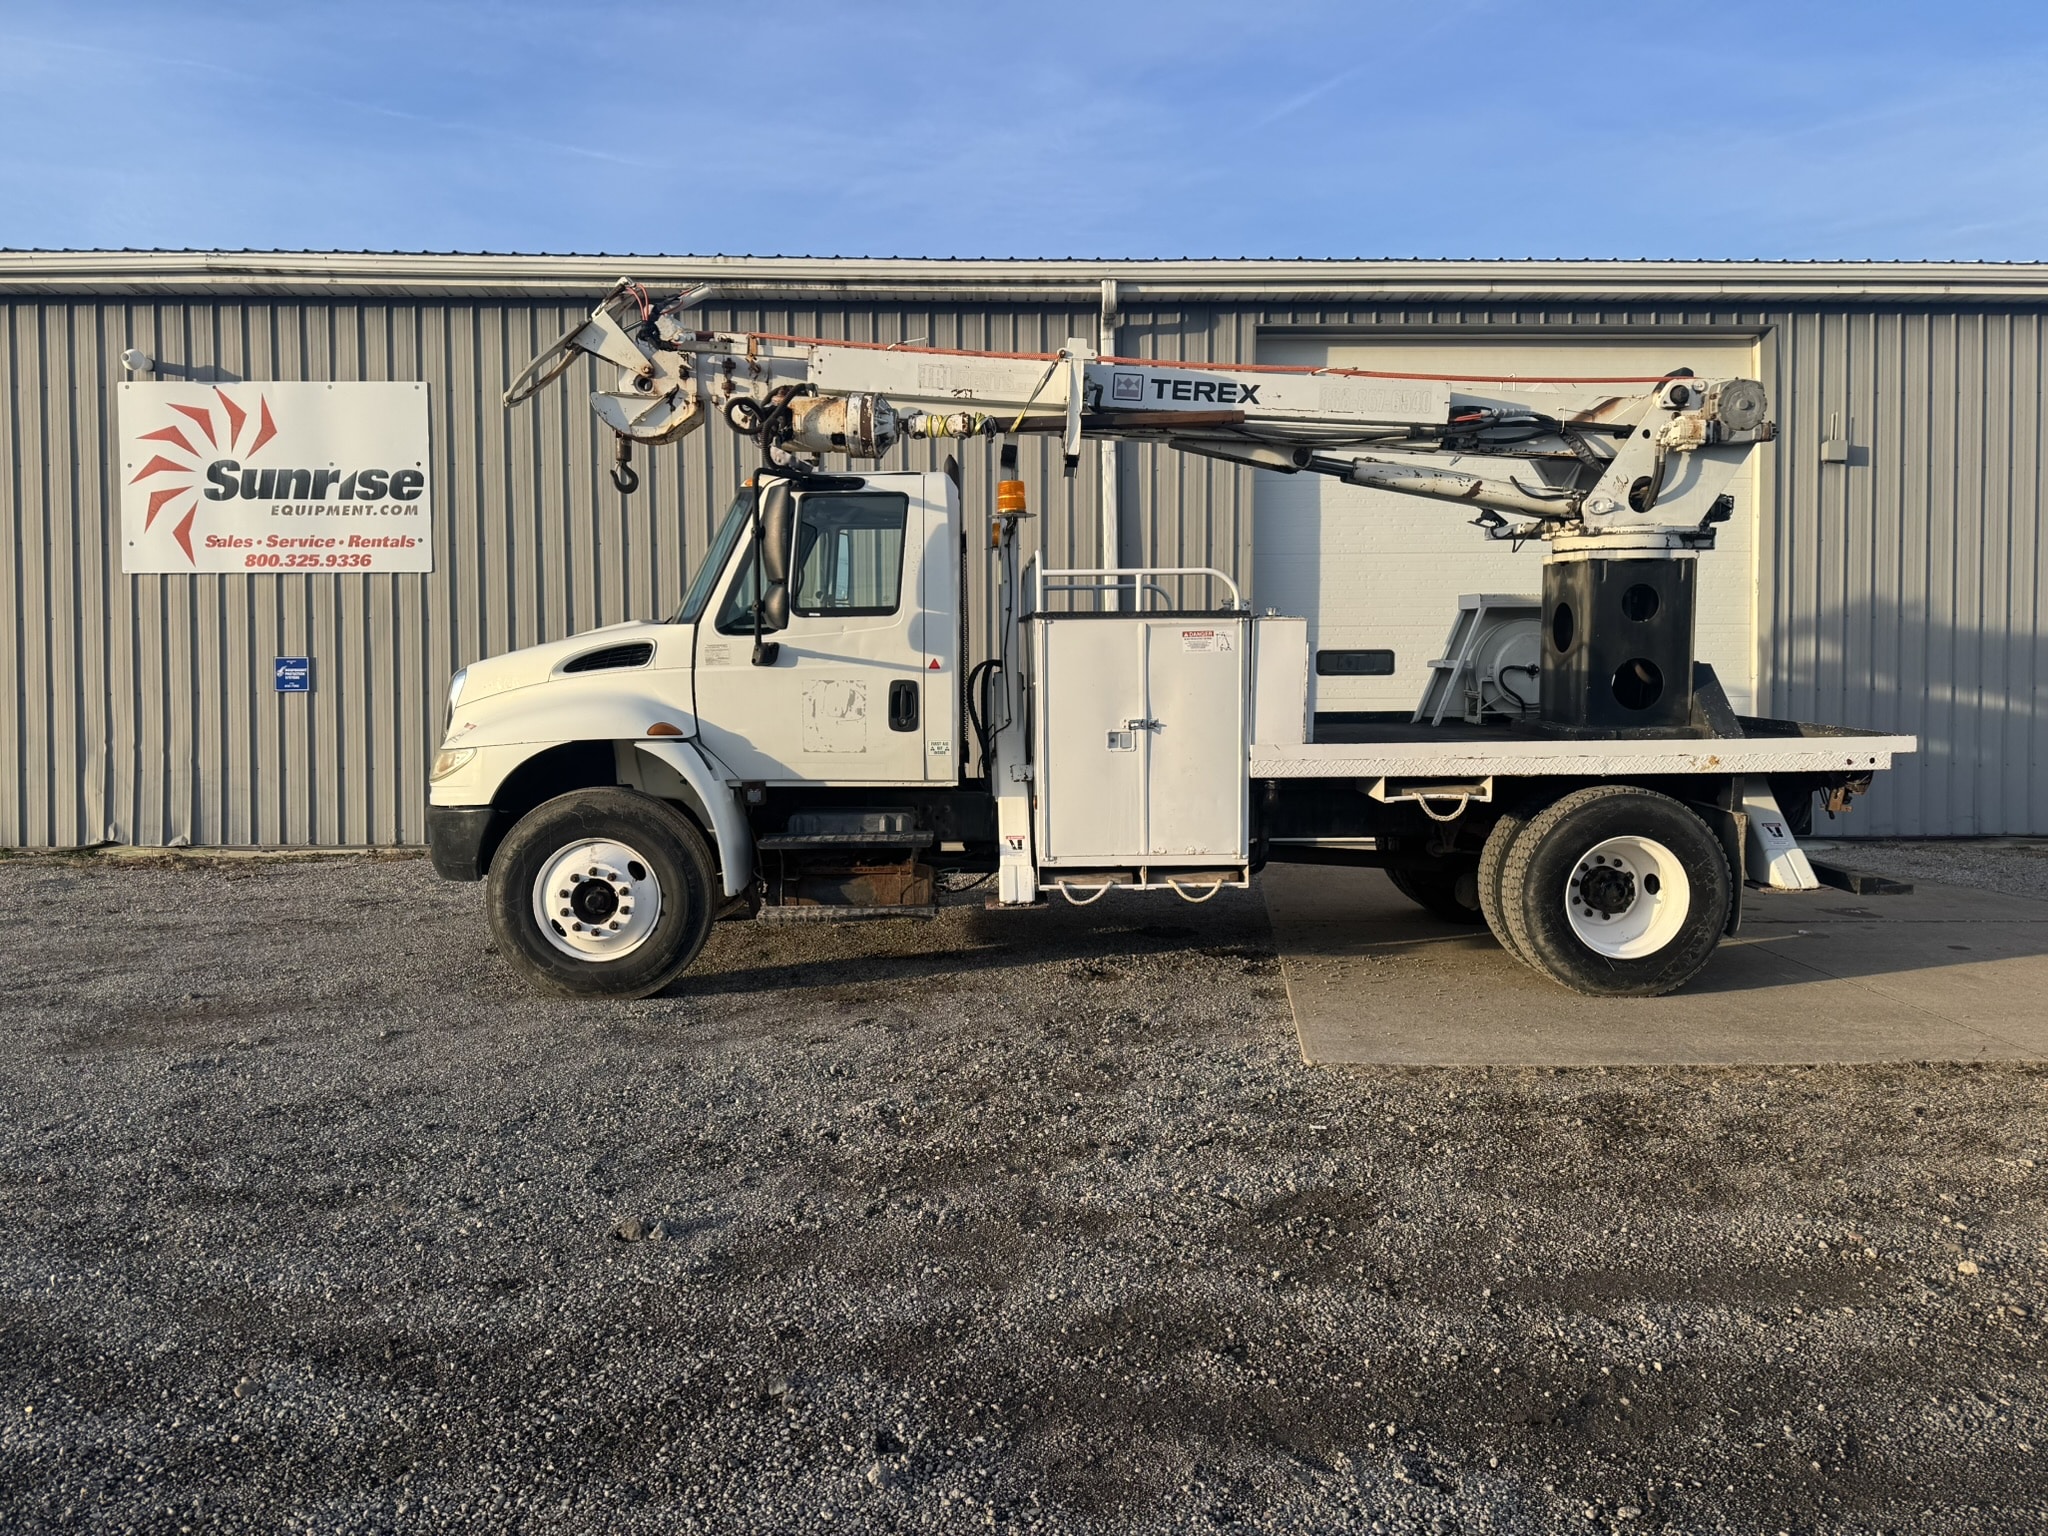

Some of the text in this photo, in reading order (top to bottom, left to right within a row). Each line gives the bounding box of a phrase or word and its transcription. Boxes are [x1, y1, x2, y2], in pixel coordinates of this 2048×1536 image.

[1151, 378, 1261, 405] TEREX
[203, 459, 425, 501] Sunrise
[271, 504, 418, 516] EQUIPMENT.COM
[205, 534, 416, 548] Sales Service Rentals
[244, 553, 372, 568] 800.325.9336
